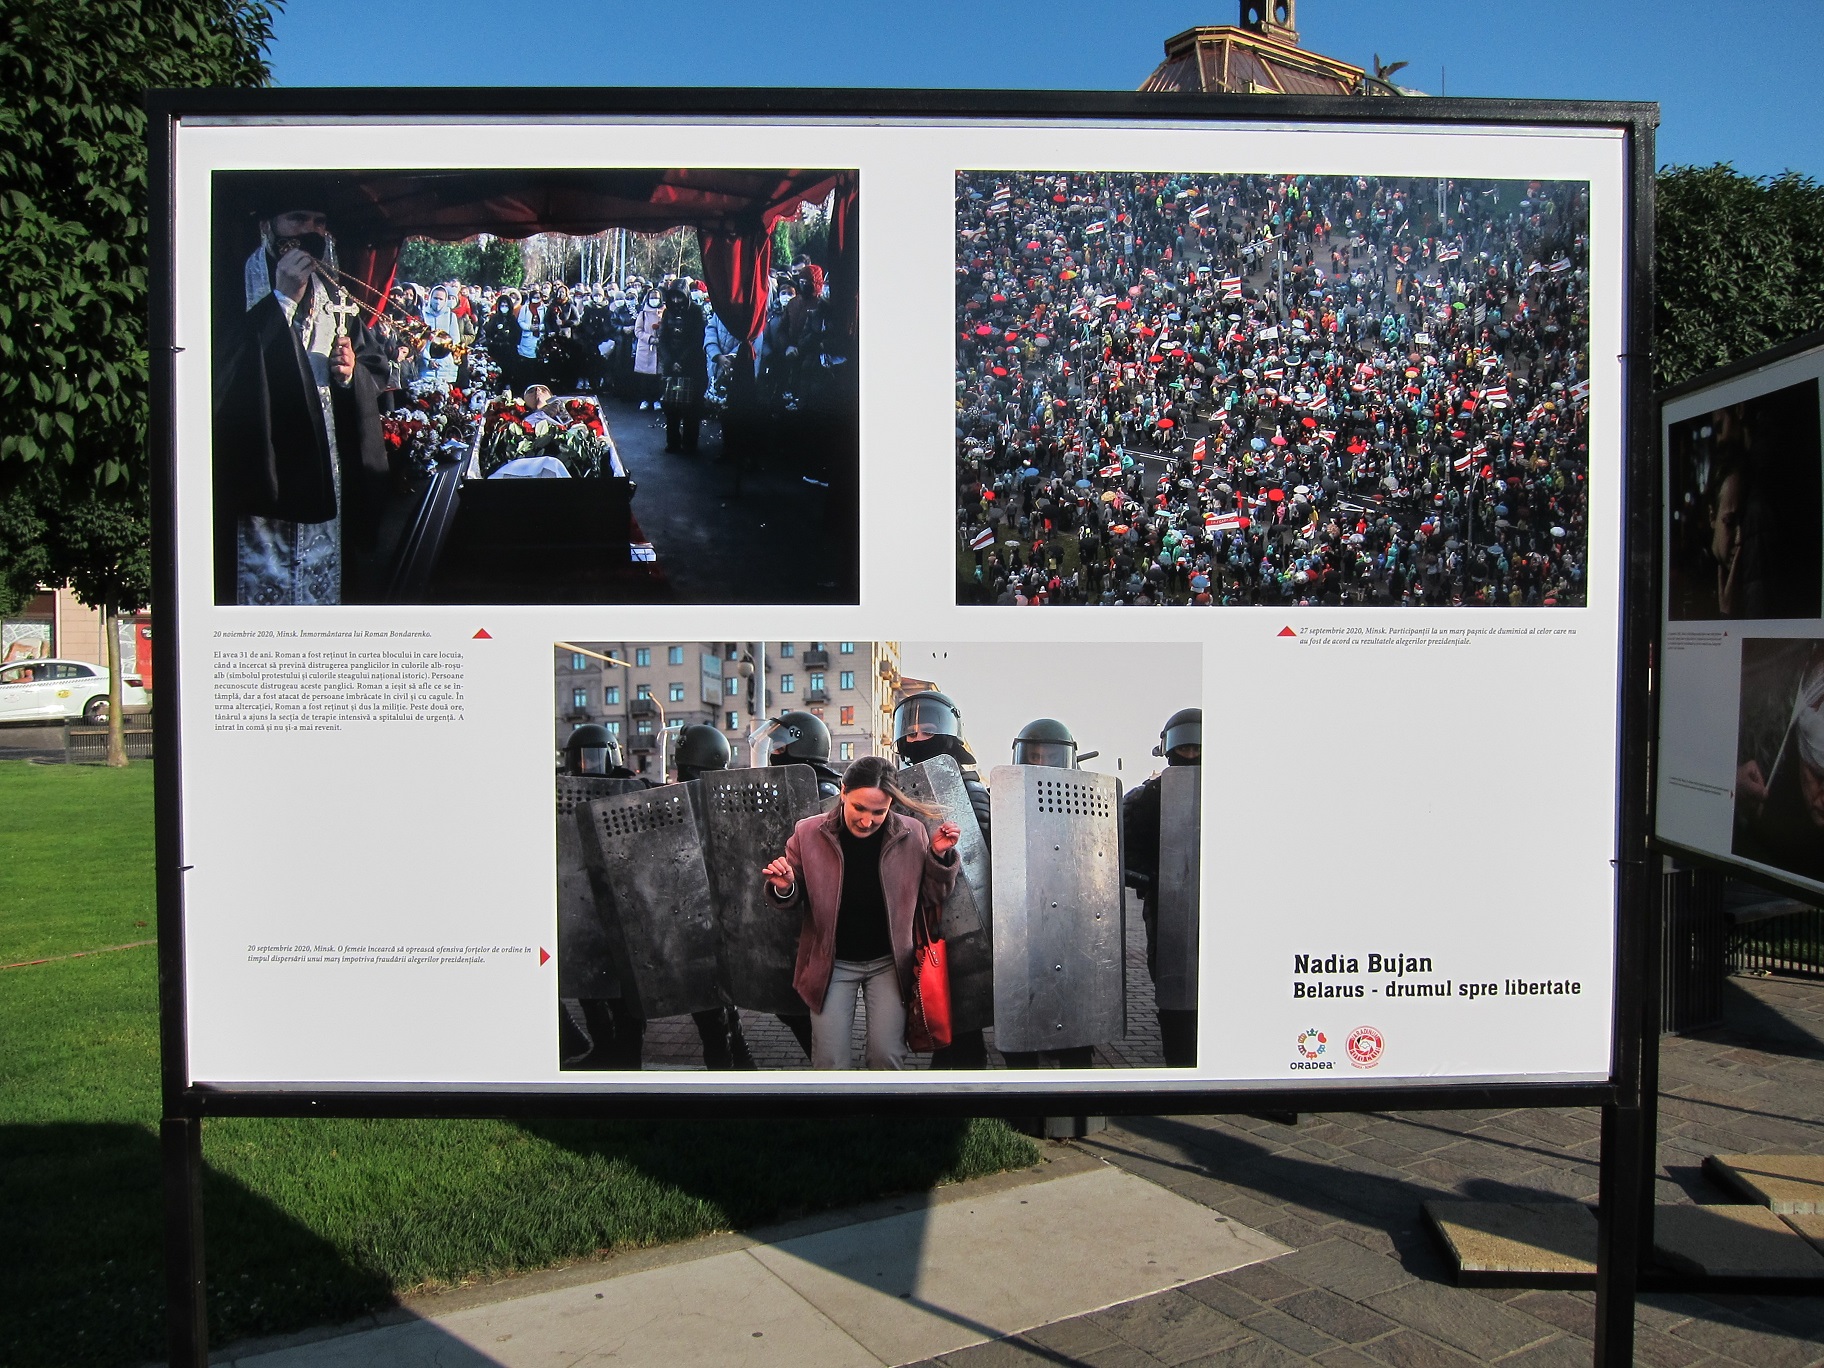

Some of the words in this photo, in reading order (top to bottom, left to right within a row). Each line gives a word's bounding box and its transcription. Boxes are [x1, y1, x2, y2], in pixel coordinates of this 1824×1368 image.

[1309, 627, 1345, 636] septembrie
[1308, 638, 1322, 646] fost
[1395, 638, 1426, 646] alegerilor
[439, 651, 464, 659] locuia,
[308, 662, 349, 670] distrugerea
[350, 662, 390, 670] panglicilor
[261, 672, 301, 680] protestului
[337, 672, 370, 681] steagului
[402, 672, 430, 680] istoric).
[260, 682, 298, 691] distrugeau
[323, 682, 355, 691] panglici.
[428, 693, 454, 701] cagule.
[311, 714, 337, 722] terapie
[379, 714, 413, 722] spitalului
[257, 945, 293, 953] septembrie
[344, 945, 366, 953] femeie
[436, 946, 464, 954] ofensiva
[247, 955, 270, 963] timpul
[407, 956, 439, 964] alegerilor
[1294, 954, 1359, 974] Nadia
[1368, 953, 1432, 977] Bujan
[1293, 982, 1365, 998] Belarus
[1385, 980, 1452, 997] drumul
[1458, 983, 1498, 1000] spre
[1504, 979, 1581, 995] libertate
